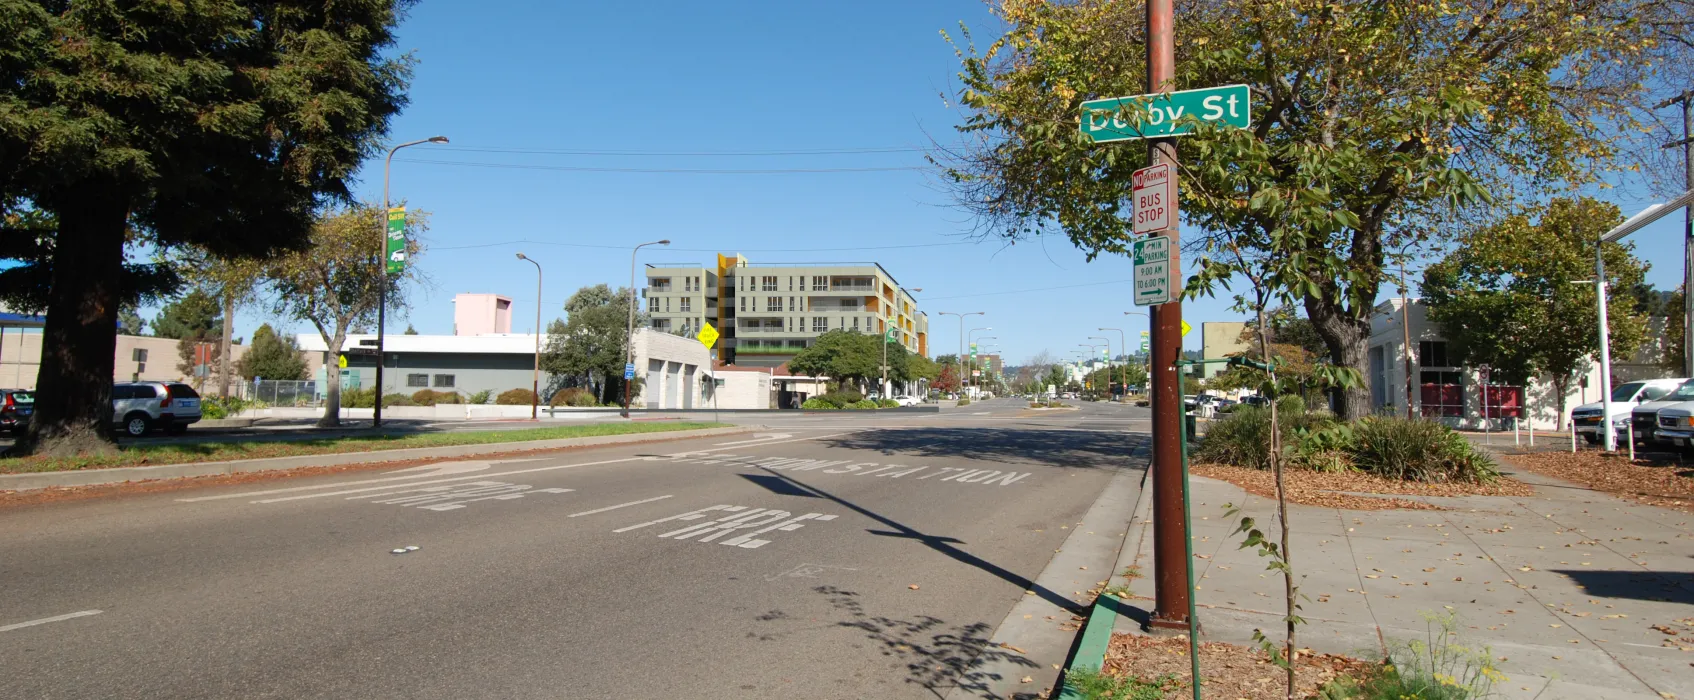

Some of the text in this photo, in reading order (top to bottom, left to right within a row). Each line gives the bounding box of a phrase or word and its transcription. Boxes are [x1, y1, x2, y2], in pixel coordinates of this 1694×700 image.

[1090, 94, 1239, 132] Dby St
[1134, 170, 1167, 187] NO PARKING
[1140, 193, 1161, 209] BUS
[1138, 207, 1164, 224] STOP
[1151, 241, 1162, 250] MIN
[1135, 248, 1144, 260] 24
[1144, 250, 1167, 261] PARKING
[1140, 265, 1163, 276] 9:00 AM
[1137, 278, 1165, 289] TO 6:00 PM
[822, 462, 1033, 485] STATION
[345, 481, 576, 511] FIRE
[612, 504, 840, 549] FIRE
